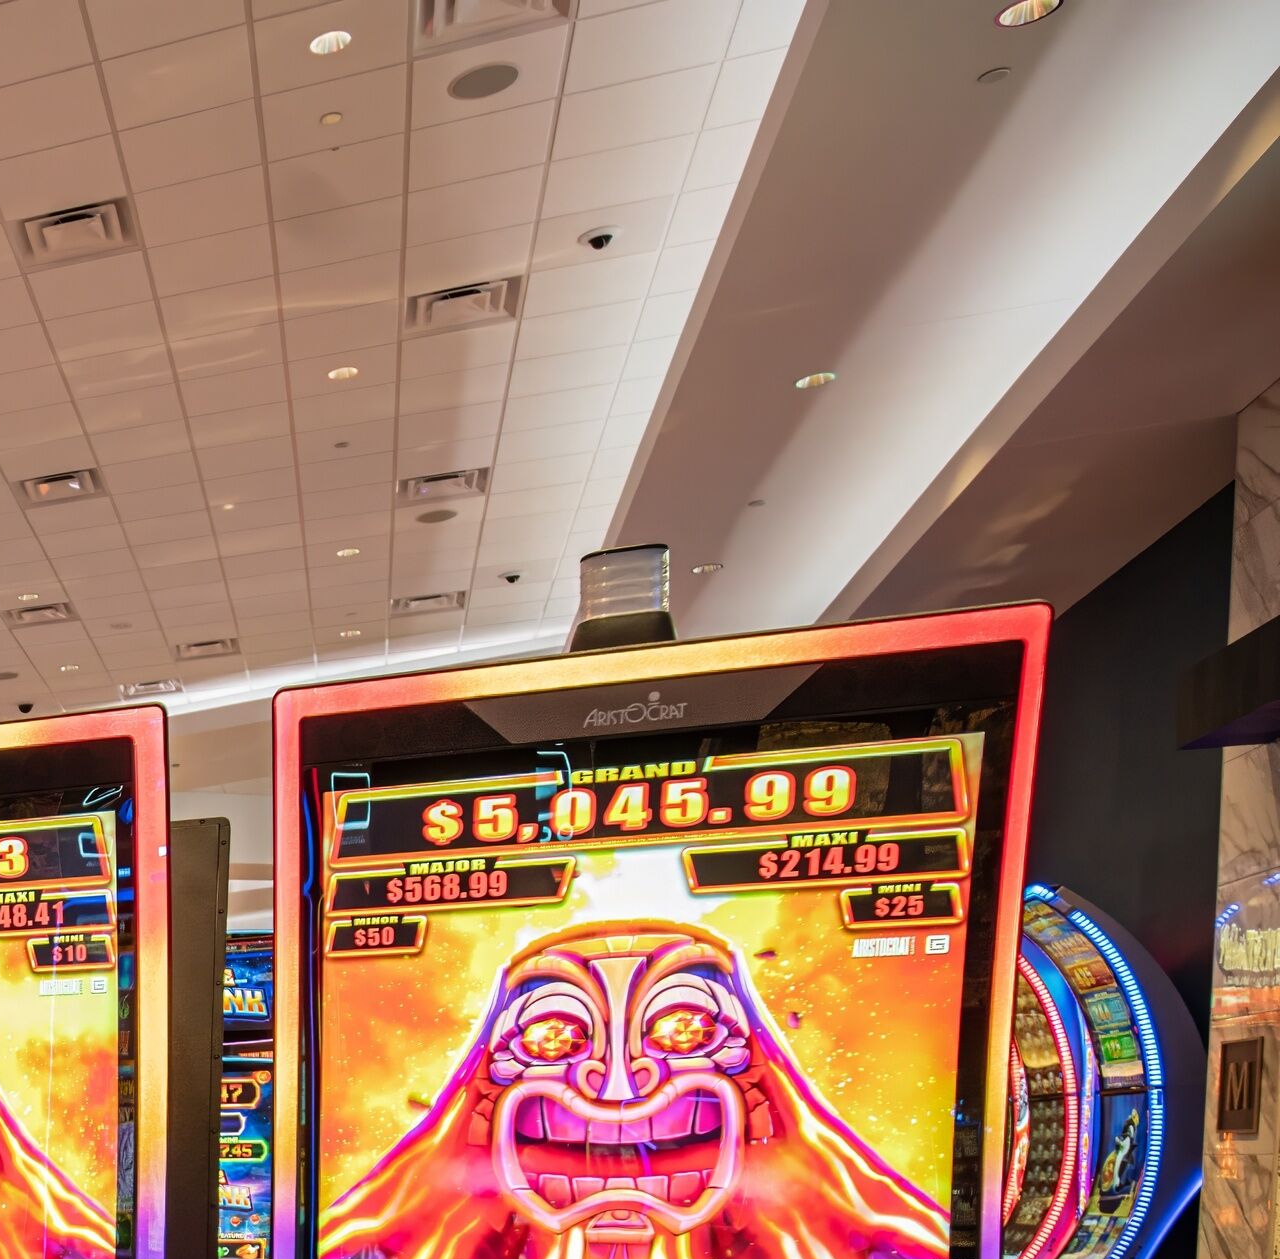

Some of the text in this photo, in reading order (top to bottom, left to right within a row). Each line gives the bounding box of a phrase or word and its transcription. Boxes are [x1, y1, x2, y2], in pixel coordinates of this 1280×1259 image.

[583, 690, 688, 728] ARISTOCRAT
[571, 760, 697, 785] GRAND
[422, 765, 857, 846] $5,045.99
[791, 831, 859, 848] MAXI
[409, 858, 486, 875] MAJOR
[758, 843, 900, 880] $214.99
[386, 870, 508, 904] $568.99
[877, 883, 922, 893] MINI
[875, 894, 925, 917] $25
[353, 916, 399, 925] MINOR
[53, 934, 85, 943] MINI
[353, 926, 395, 947] $50
[51, 944, 88, 963] $10
